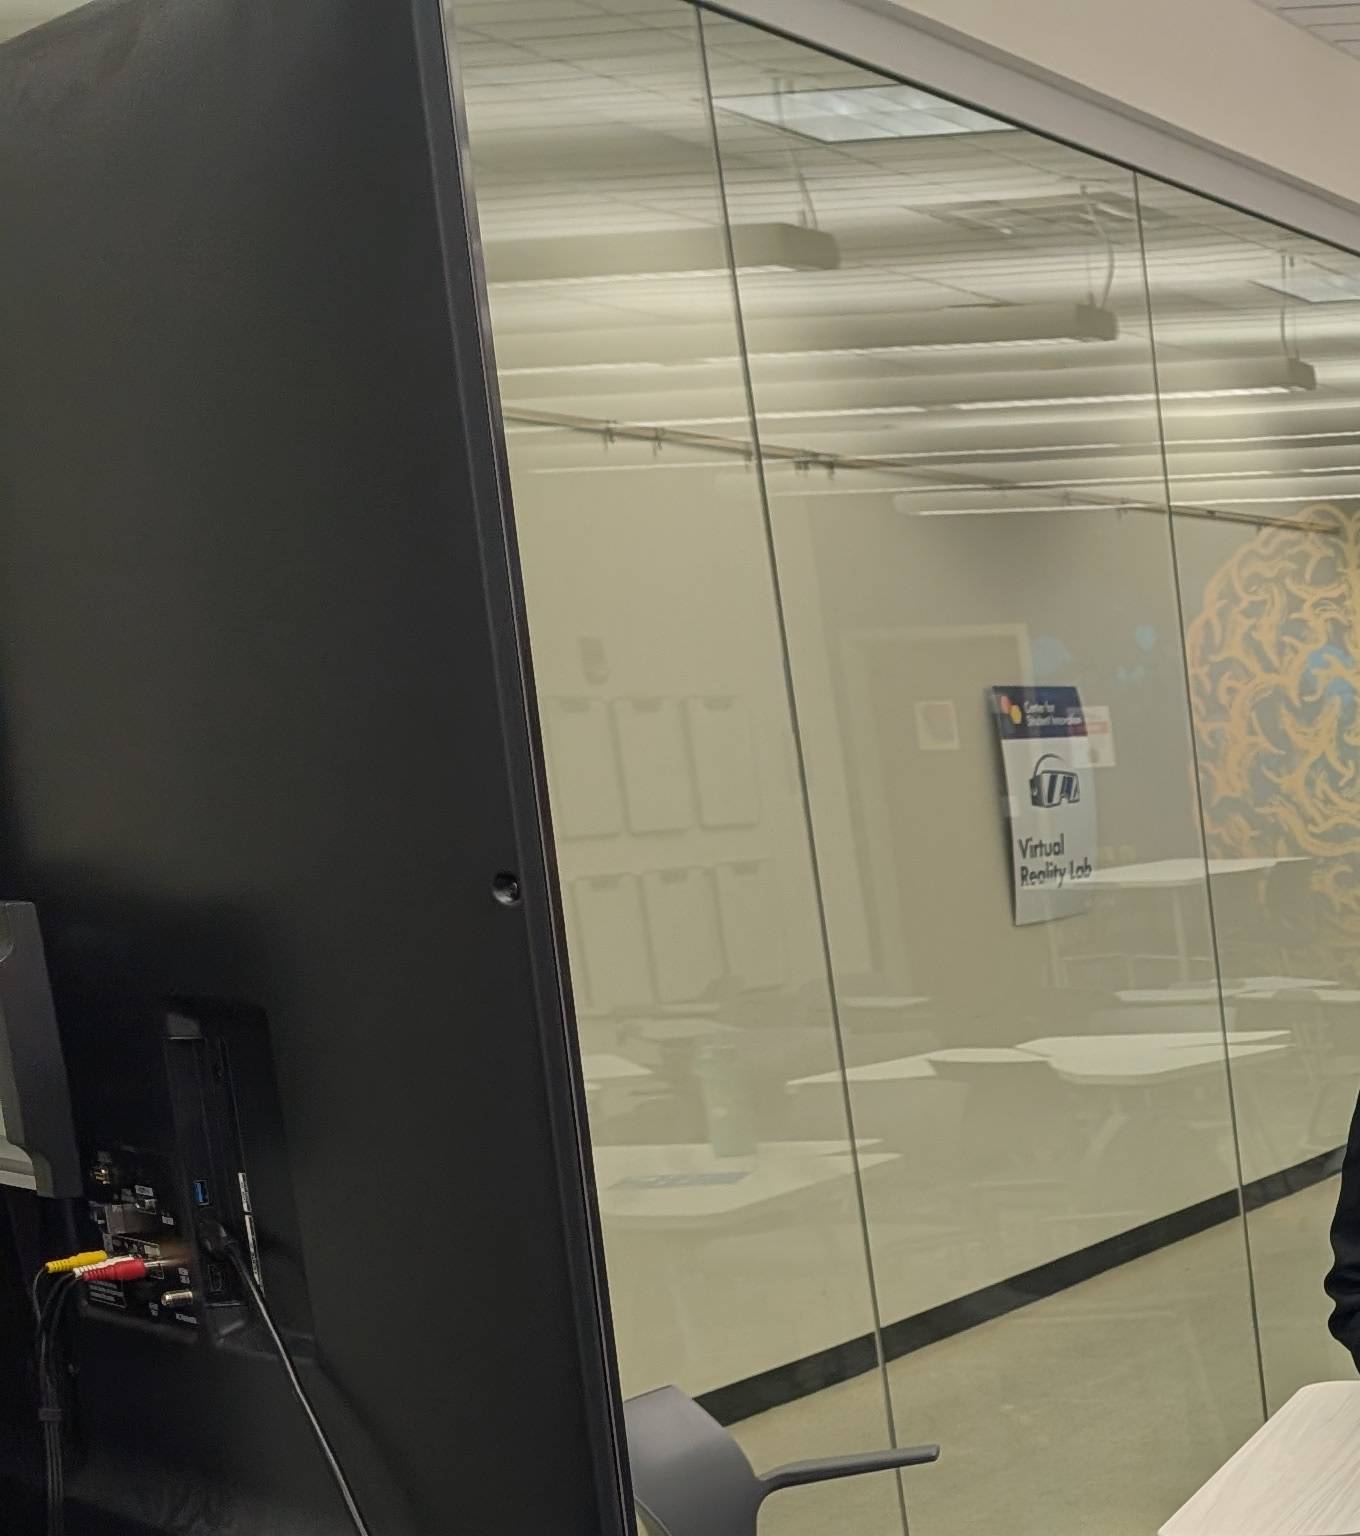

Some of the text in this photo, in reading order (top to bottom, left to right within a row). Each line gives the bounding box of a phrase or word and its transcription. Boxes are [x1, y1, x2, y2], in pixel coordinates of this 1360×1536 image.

[1018, 834, 1065, 858] Virtual
[1020, 857, 1093, 888] Reality Lab
